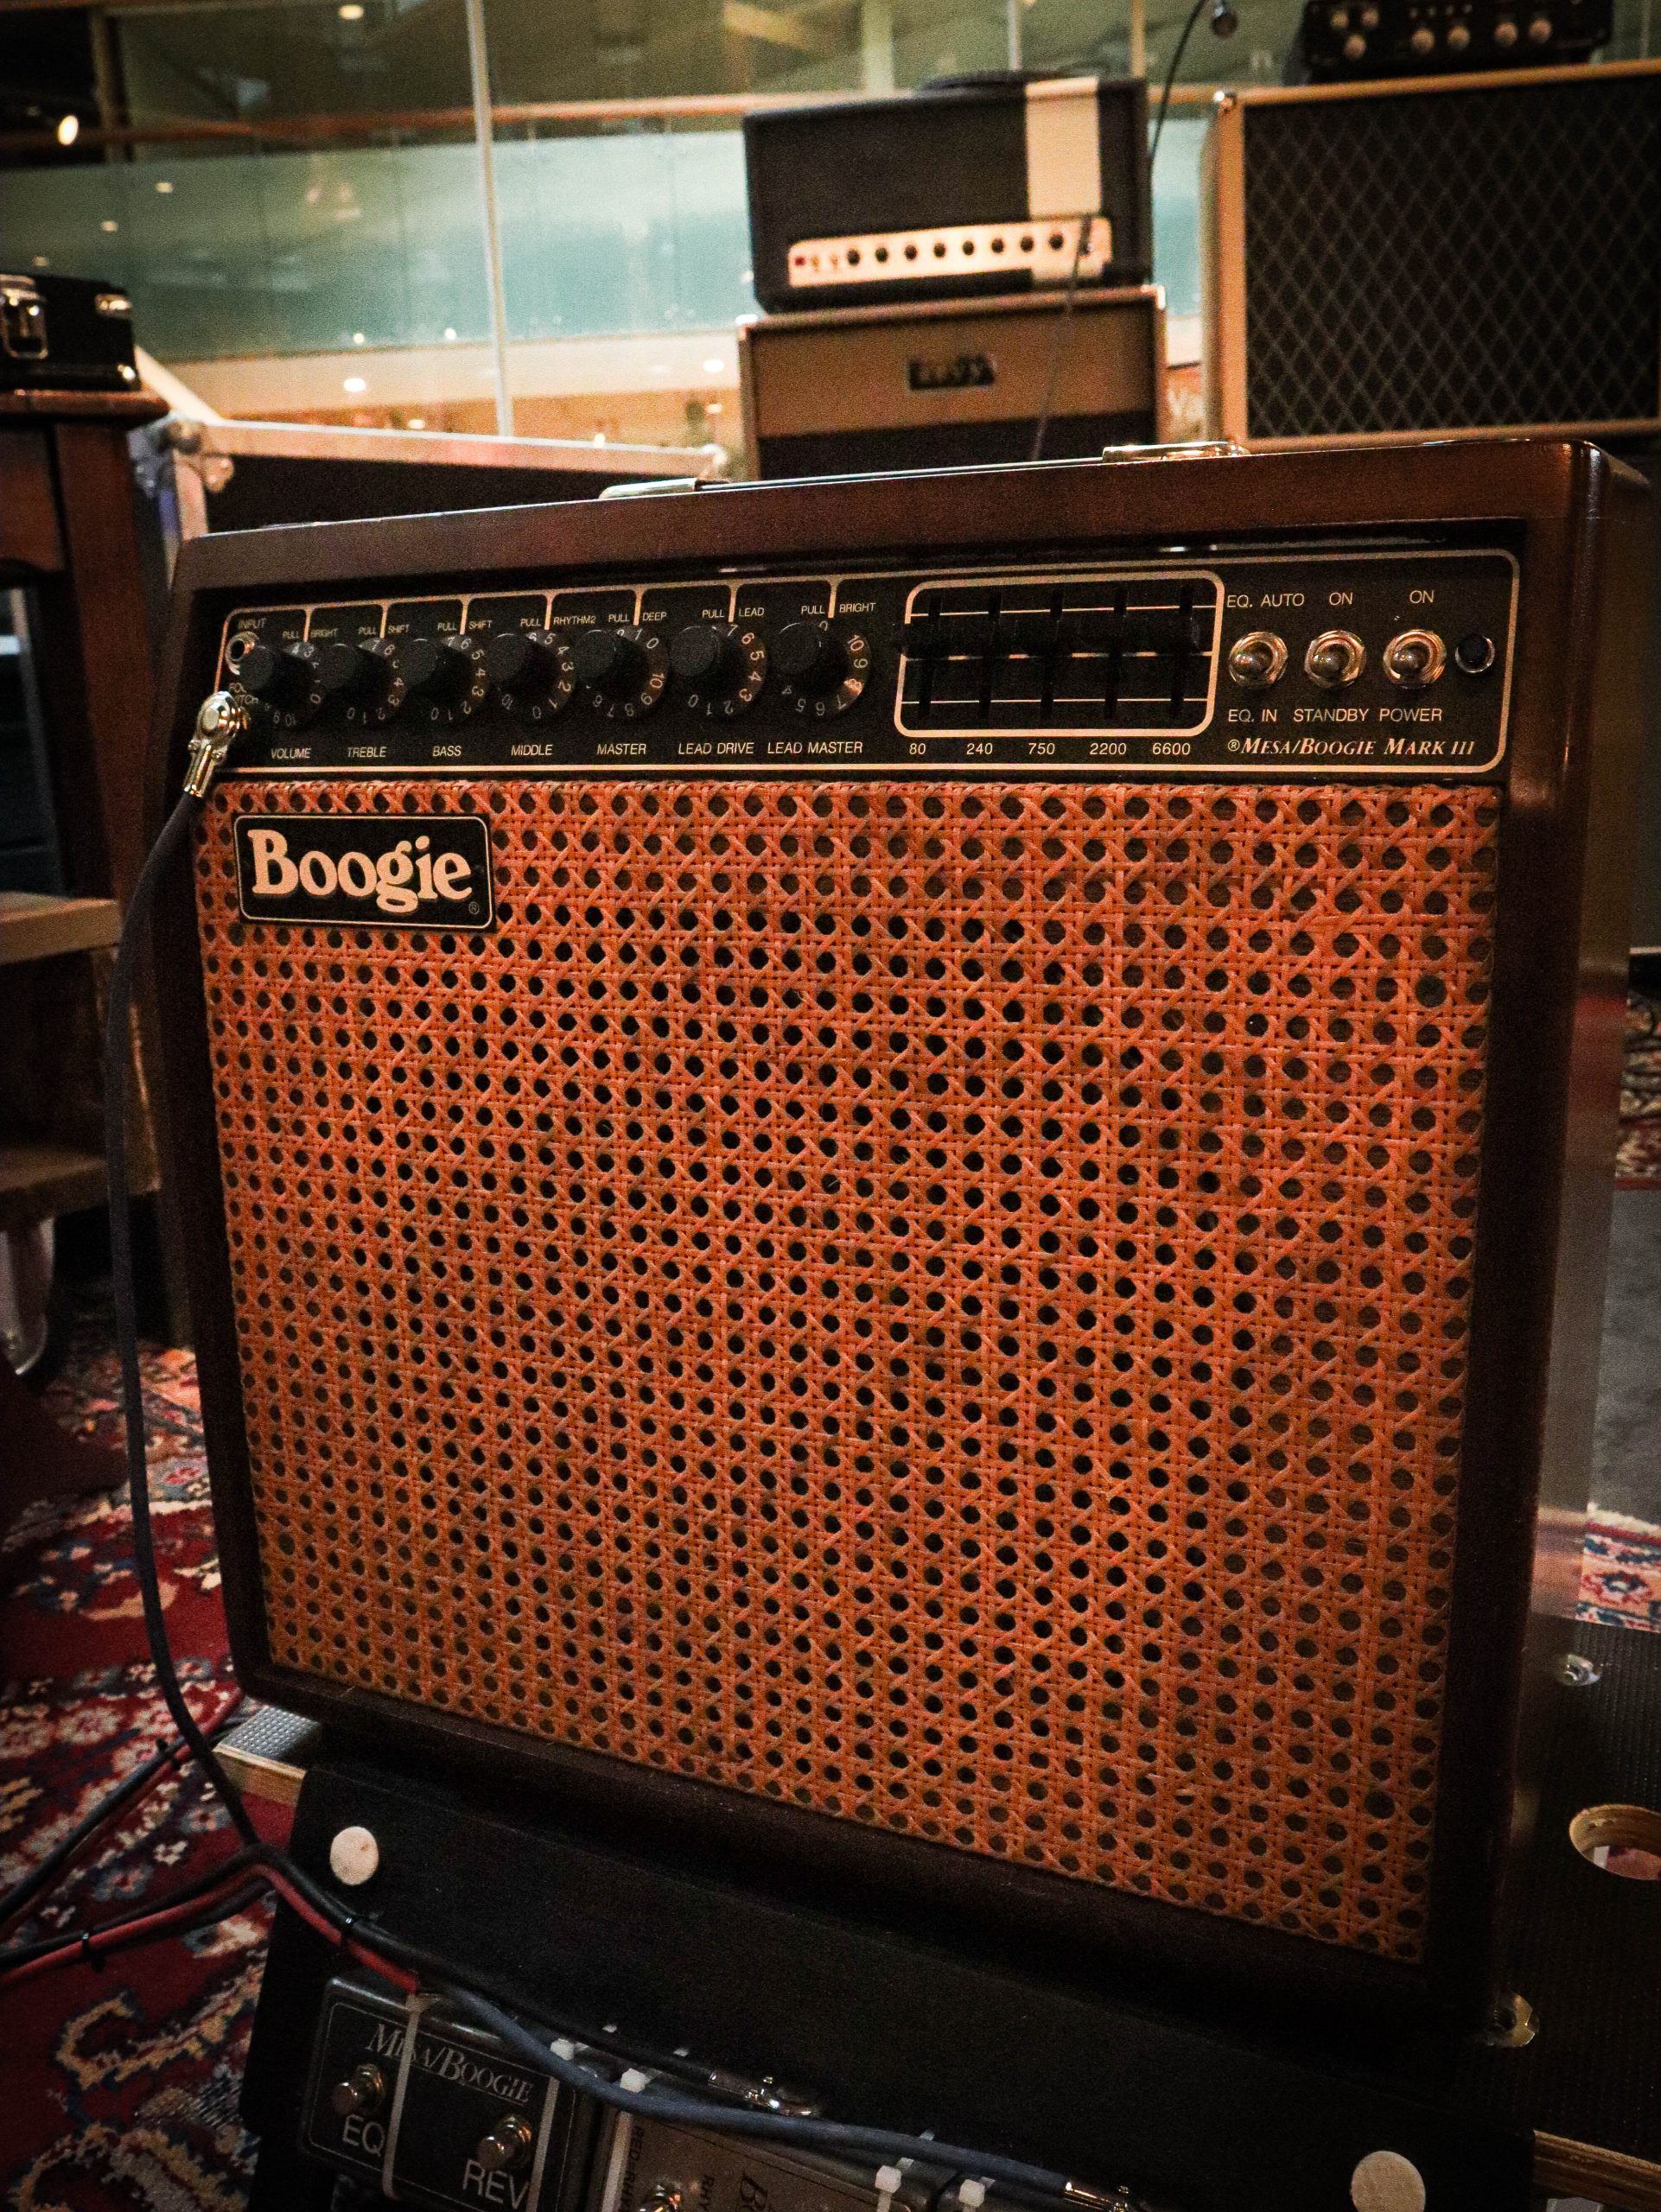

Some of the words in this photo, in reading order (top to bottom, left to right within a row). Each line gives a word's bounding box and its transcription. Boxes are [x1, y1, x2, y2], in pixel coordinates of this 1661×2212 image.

[1226, 594, 1253, 608] EQ.
[1260, 593, 1305, 607] AUTO
[1328, 592, 1353, 605] ON
[1410, 590, 1435, 604] ON
[702, 608, 725, 619] PULL
[738, 607, 765, 617] LEAD
[800, 605, 826, 614] PULL
[838, 602, 876, 613] BRIGHT
[520, 618, 541, 627] PULL
[553, 615, 596, 626] RHYTHM2
[608, 613, 630, 622] PULL
[642, 611, 667, 621] DEEP
[358, 626, 377, 635] PULL
[437, 622, 456, 632] PULL
[468, 620, 493, 630] SHIFT
[1228, 709, 1255, 722] EQ.
[1261, 709, 1277, 721] IN
[1293, 708, 1369, 721] STANDBY
[1380, 708, 1442, 721] POWER
[432, 745, 461, 757] BASS
[511, 744, 553, 756] MIDDLE
[596, 743, 646, 755] MASTER
[678, 742, 712, 754] LEAD
[716, 742, 754, 754] DRIVE
[767, 741, 803, 754] LEAD
[807, 741, 863, 754] MASTER
[909, 743, 926, 754] 80
[966, 742, 993, 754] 240
[1028, 742, 1055, 754] 750
[1090, 742, 1127, 754] 2200
[1152, 742, 1191, 754] 6600
[1383, 738, 1446, 754] MARK
[1450, 741, 1475, 754] III
[270, 747, 312, 759] VOLUME
[347, 747, 387, 758] TREBLE
[247, 830, 473, 913] Boogie
[341, 2114, 385, 2157] EQ
[461, 2158, 530, 2210] REV
